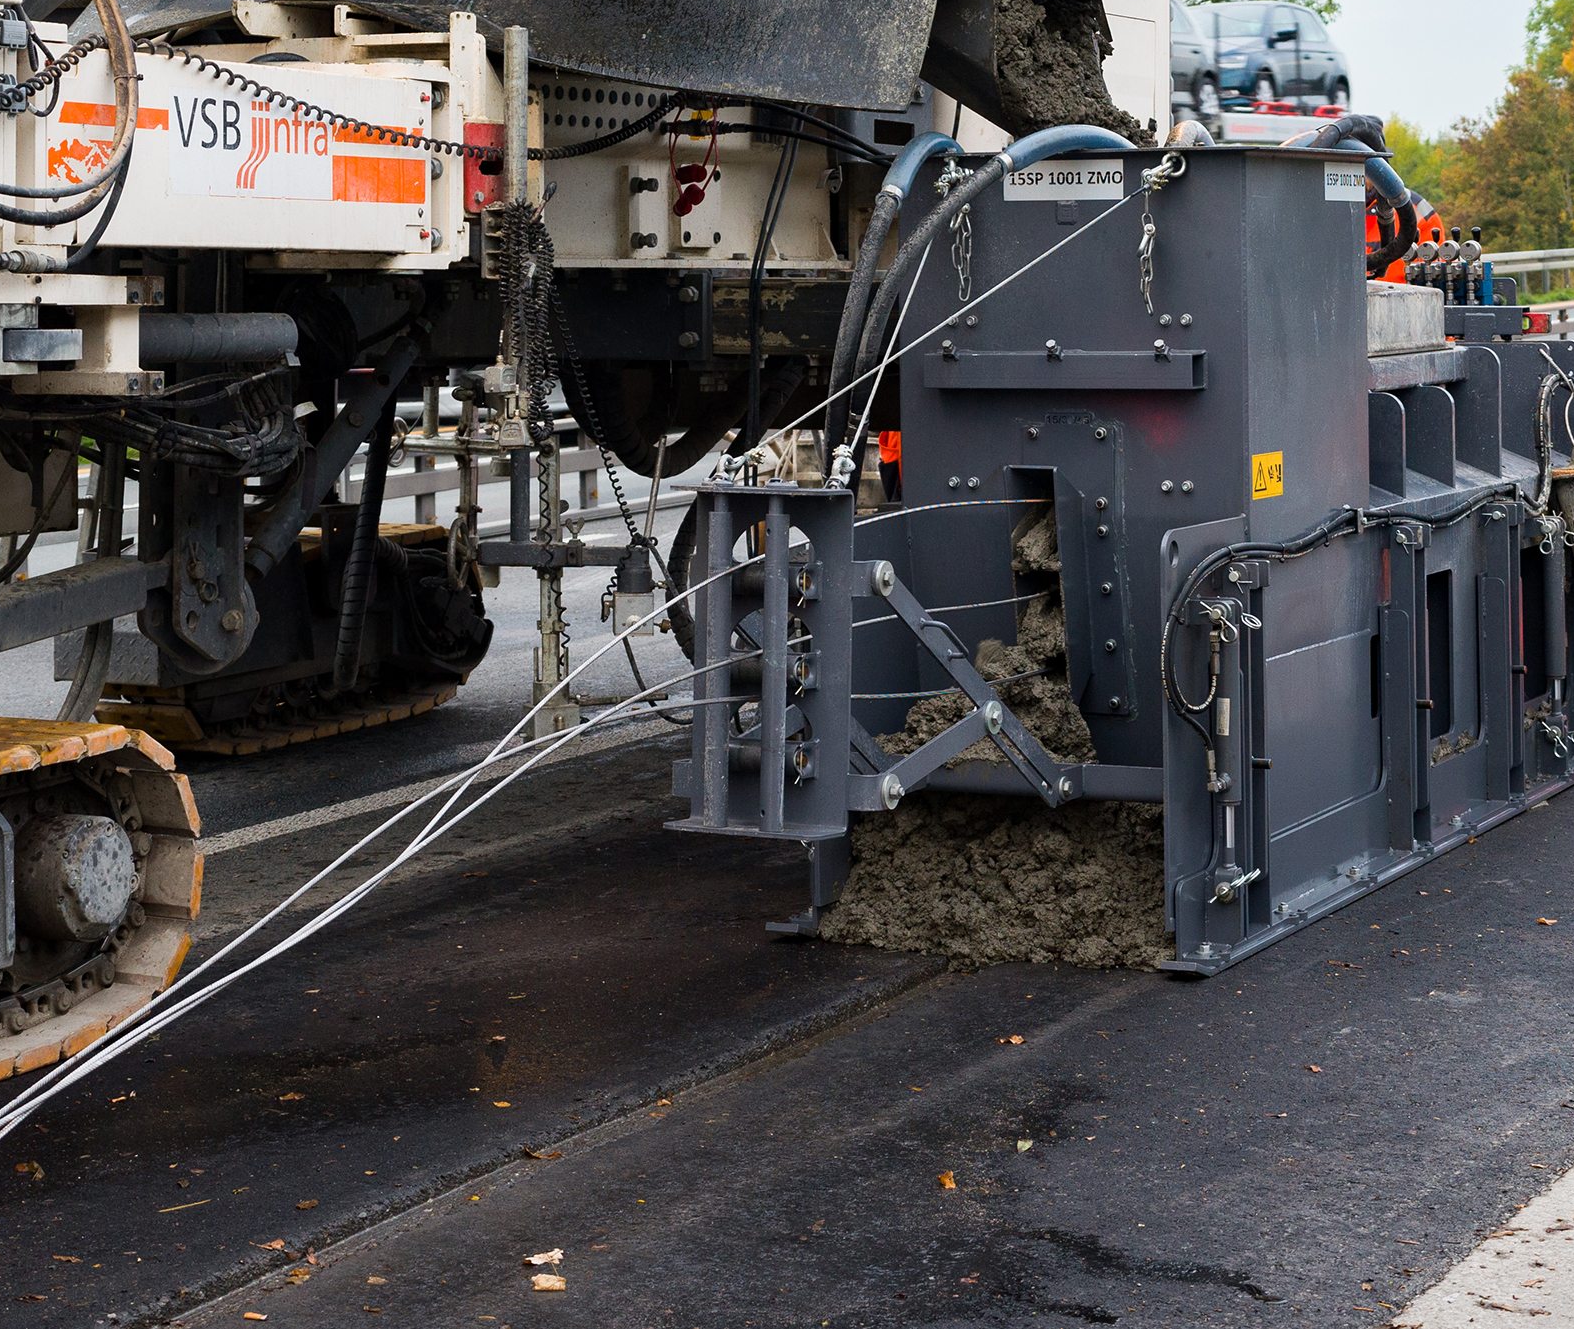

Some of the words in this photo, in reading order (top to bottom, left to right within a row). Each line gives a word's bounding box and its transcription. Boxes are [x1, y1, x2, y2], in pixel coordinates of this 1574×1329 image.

[173, 95, 242, 151] VSB
[1008, 172, 1044, 186] 15SP
[1048, 171, 1083, 185] 1001
